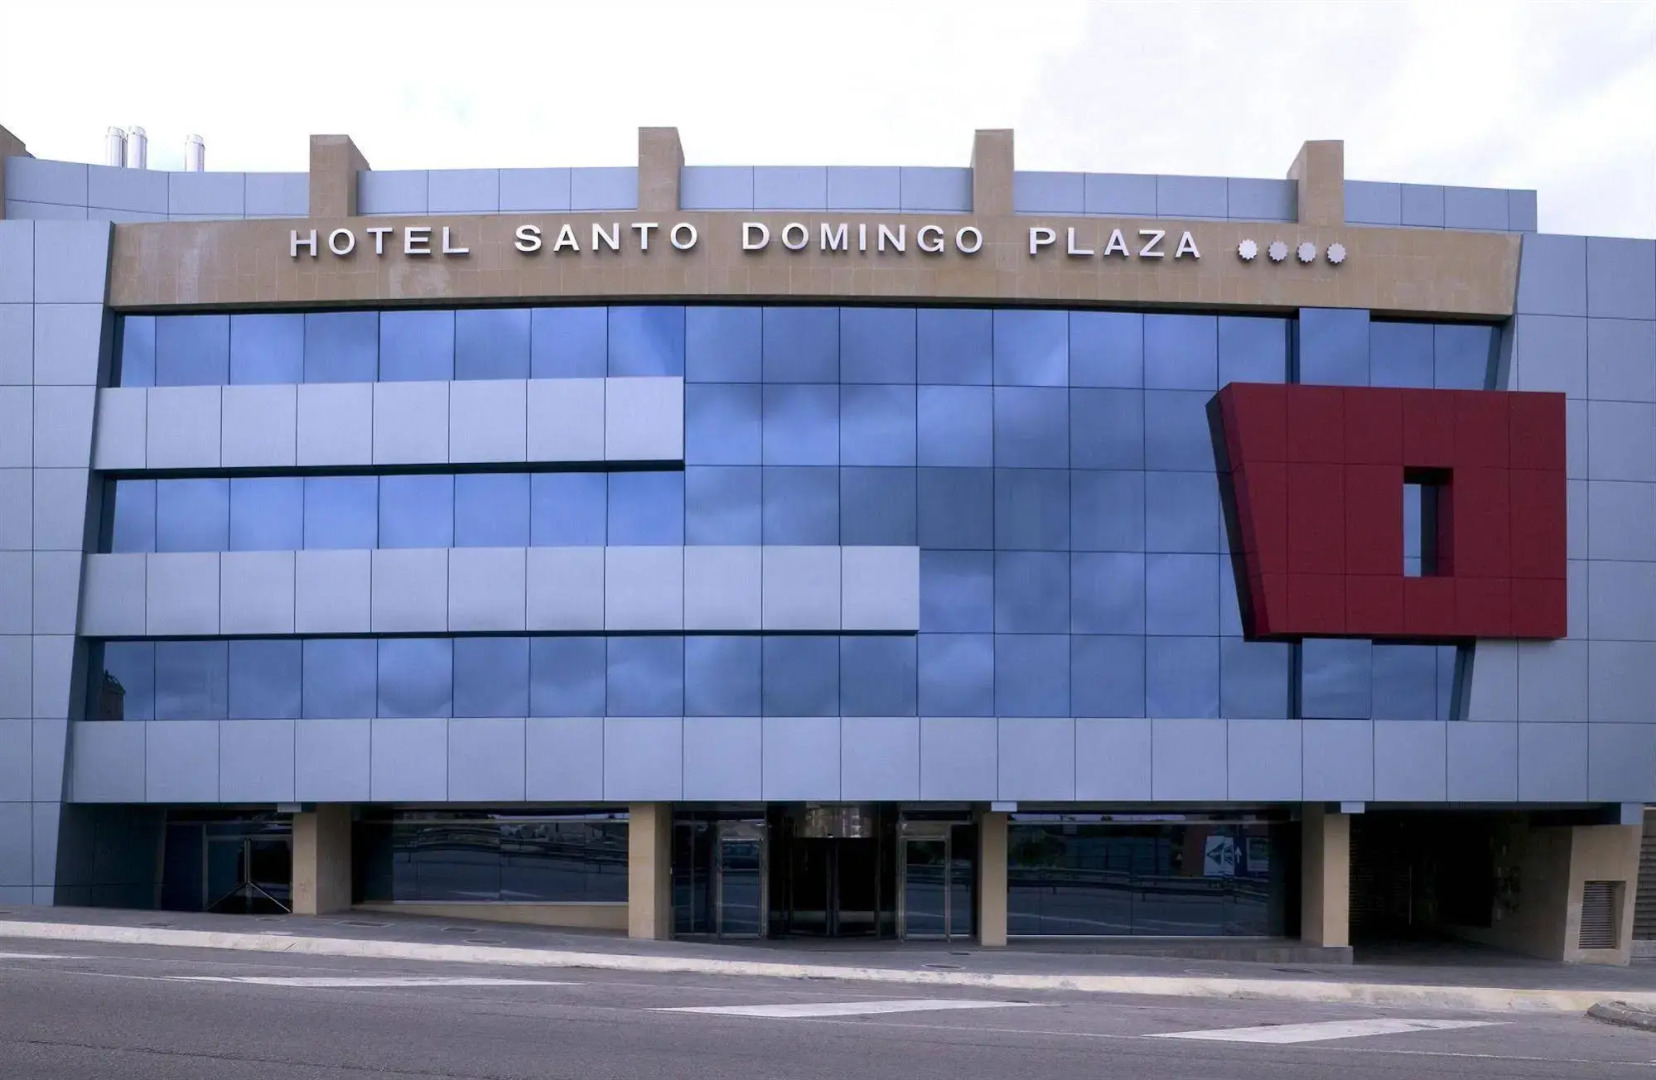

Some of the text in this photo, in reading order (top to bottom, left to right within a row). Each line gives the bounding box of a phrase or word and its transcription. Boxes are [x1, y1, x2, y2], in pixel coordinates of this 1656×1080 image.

[290, 222, 1201, 258] HOTEL SANTO DOMINGO PLAZA
